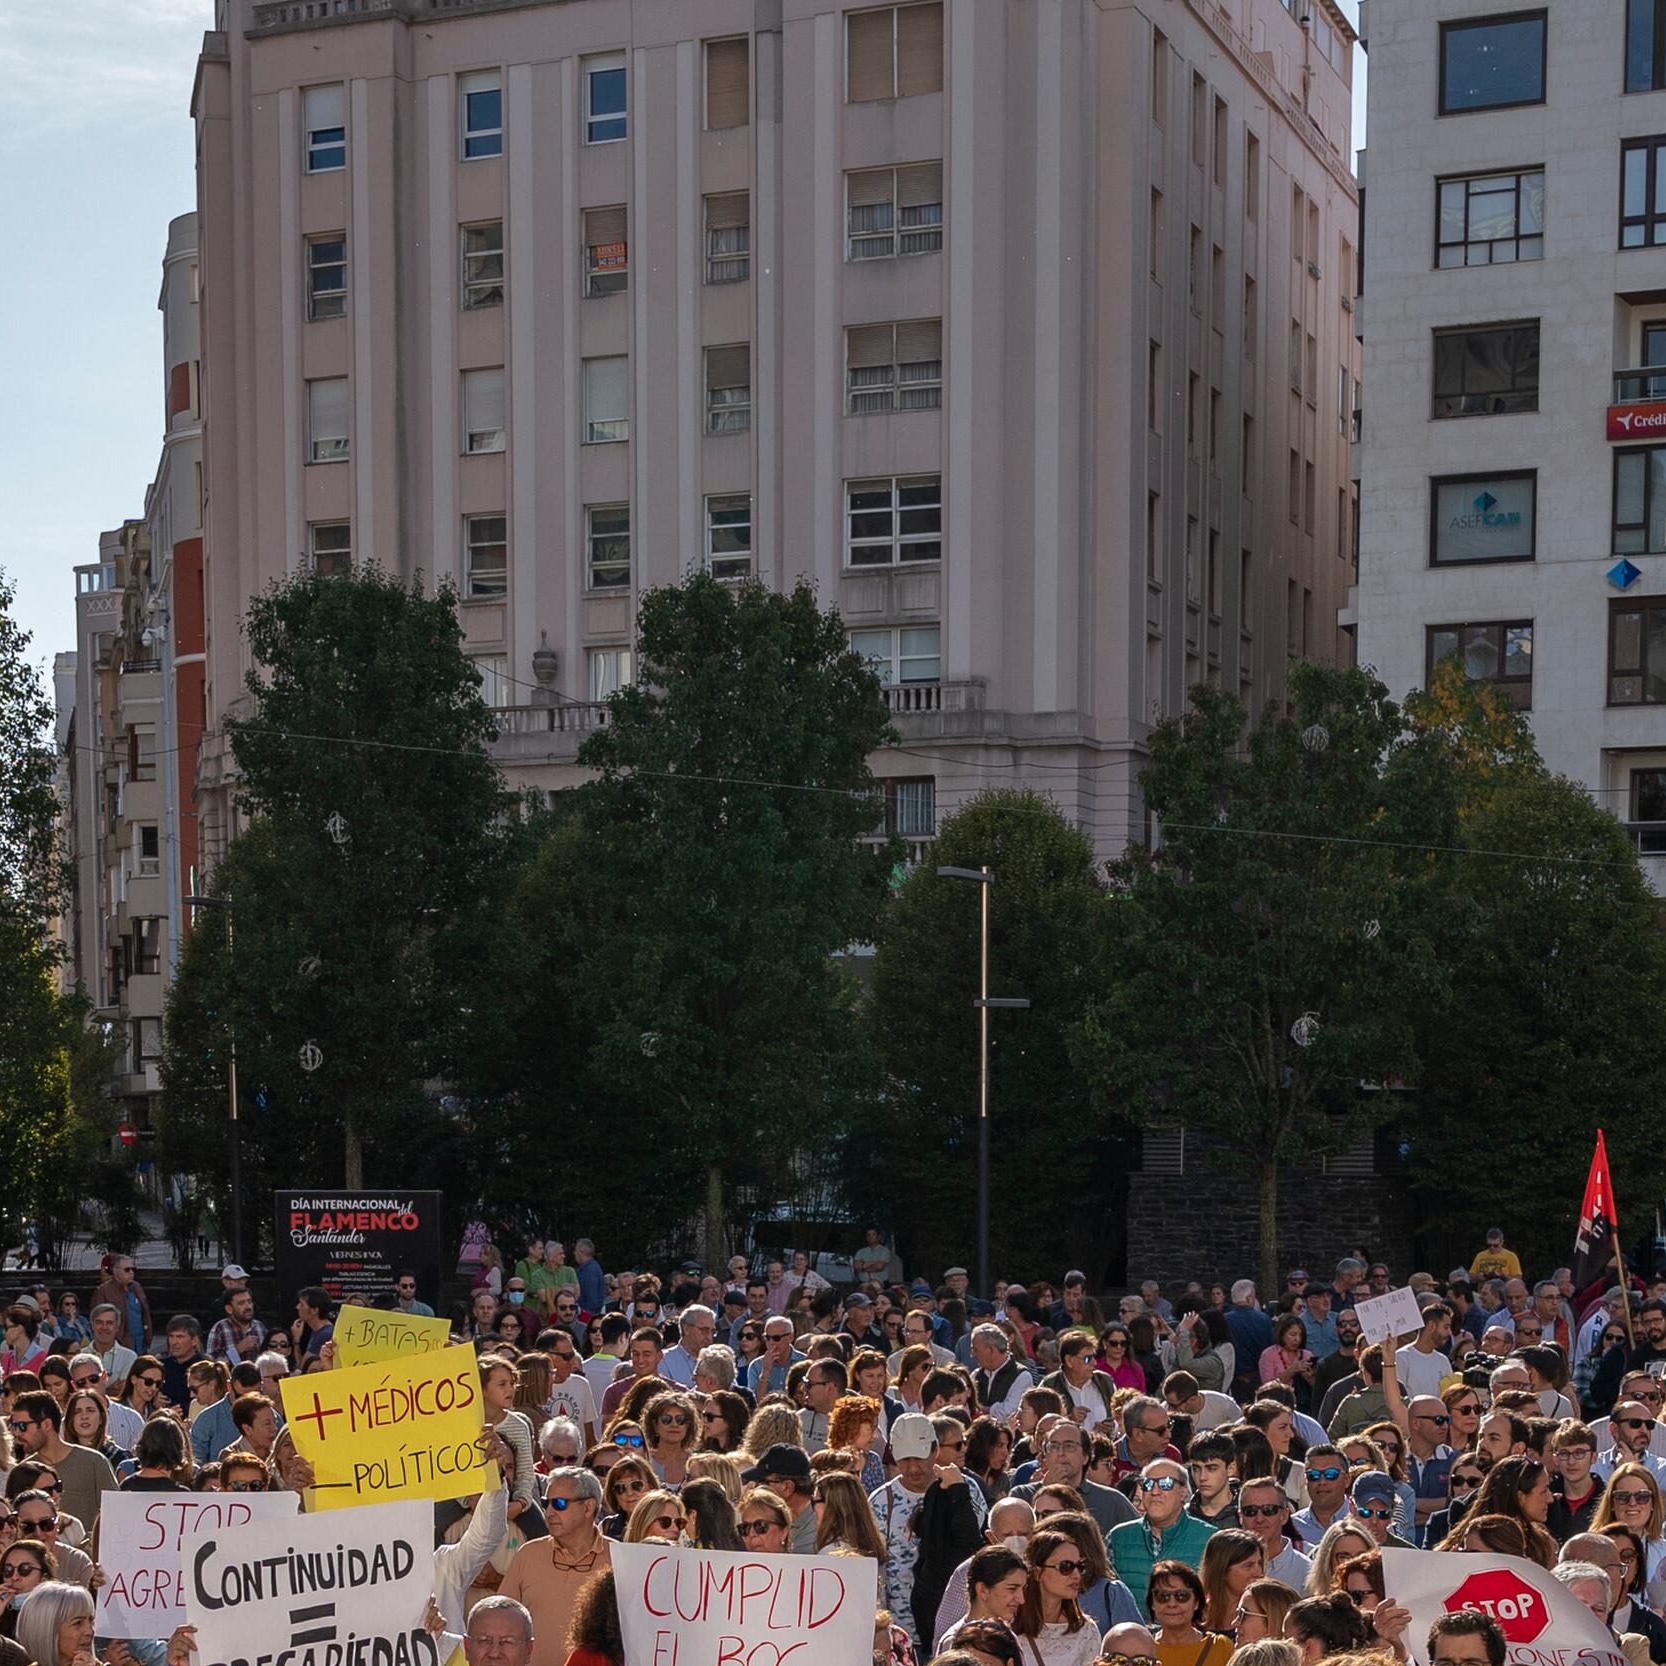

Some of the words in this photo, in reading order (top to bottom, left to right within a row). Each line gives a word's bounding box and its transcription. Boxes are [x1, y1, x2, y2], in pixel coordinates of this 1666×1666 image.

[290, 1197, 311, 1210] DÍA
[312, 1199, 401, 1210] INTERNACIONAL
[290, 1212, 419, 1231] FLAMENCO
[290, 1225, 367, 1248] Santander
[358, 1319, 432, 1353] BATAS
[349, 1372, 475, 1433] MÉDICOS
[353, 1437, 490, 1495] POLÍTICOS
[193, 1538, 415, 1611] CONTINUIDAD
[643, 1555, 846, 1630] CUMPLID
[1461, 1592, 1534, 1620] STOP
